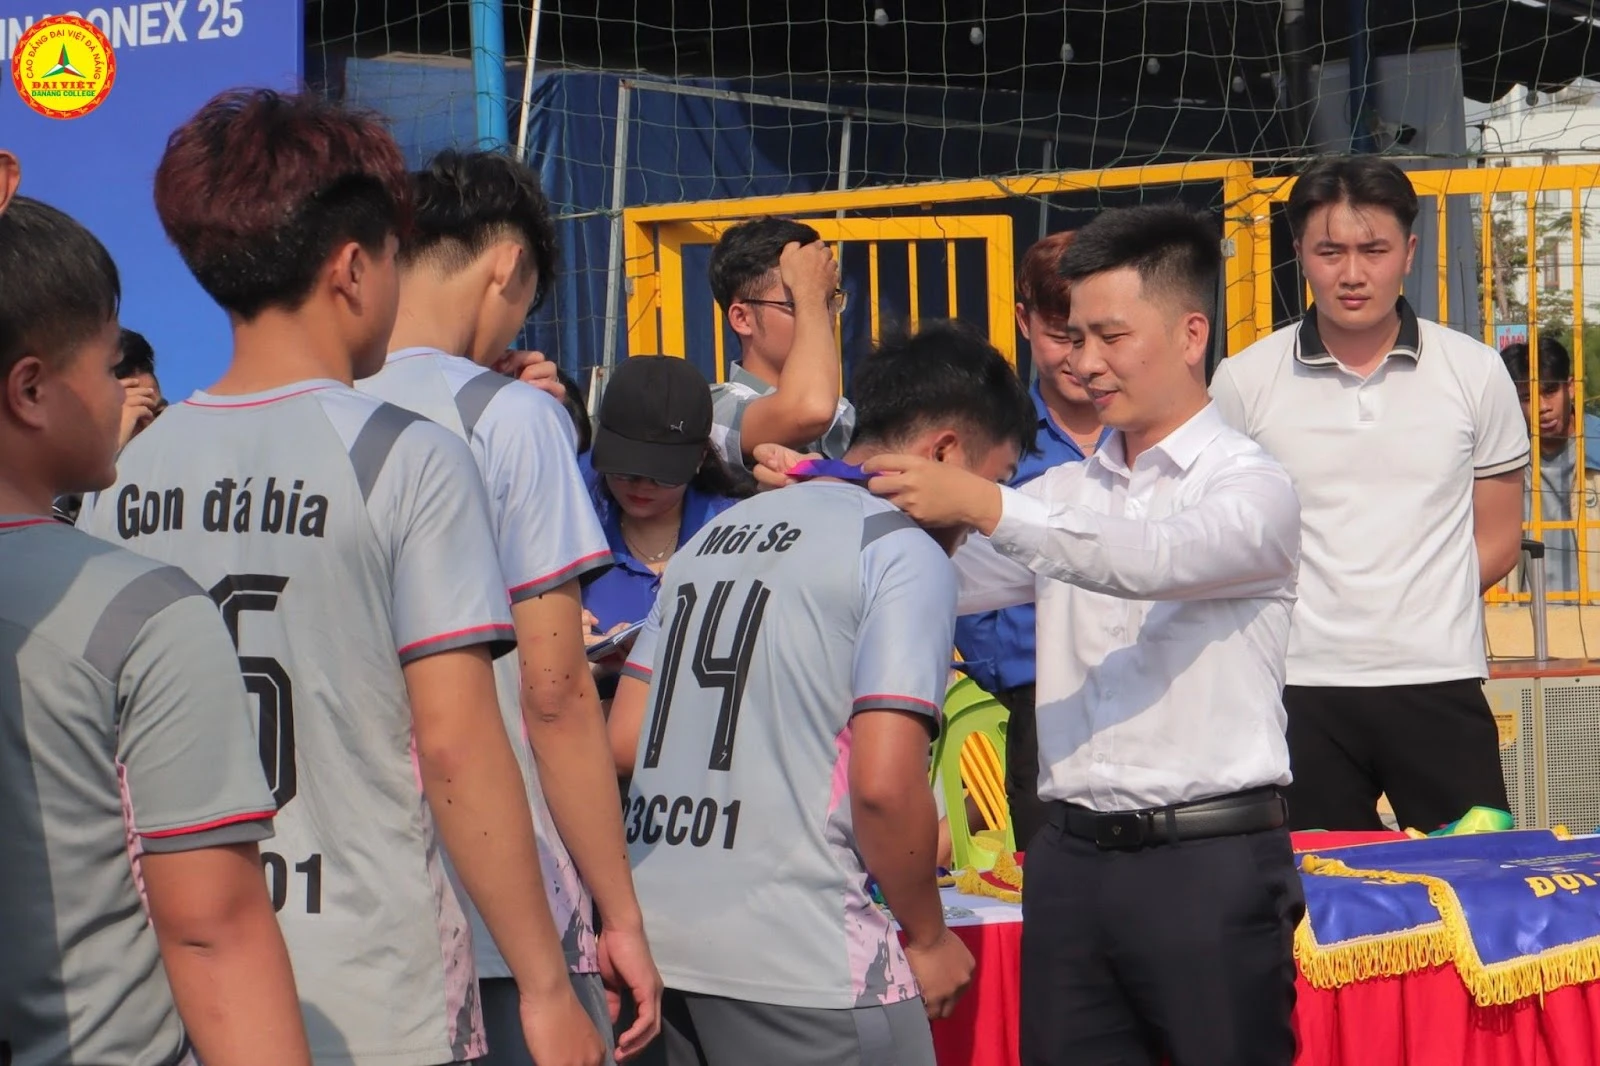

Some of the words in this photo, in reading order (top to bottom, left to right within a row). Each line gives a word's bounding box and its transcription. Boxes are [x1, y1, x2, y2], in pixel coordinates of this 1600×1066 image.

[197, 0, 244, 40] 25
[117, 483, 184, 540] Gon
[203, 476, 253, 533] đá
[260, 476, 329, 538] bia
[696, 524, 764, 557] Môi
[756, 521, 802, 553] Se
[643, 578, 771, 771] 14
